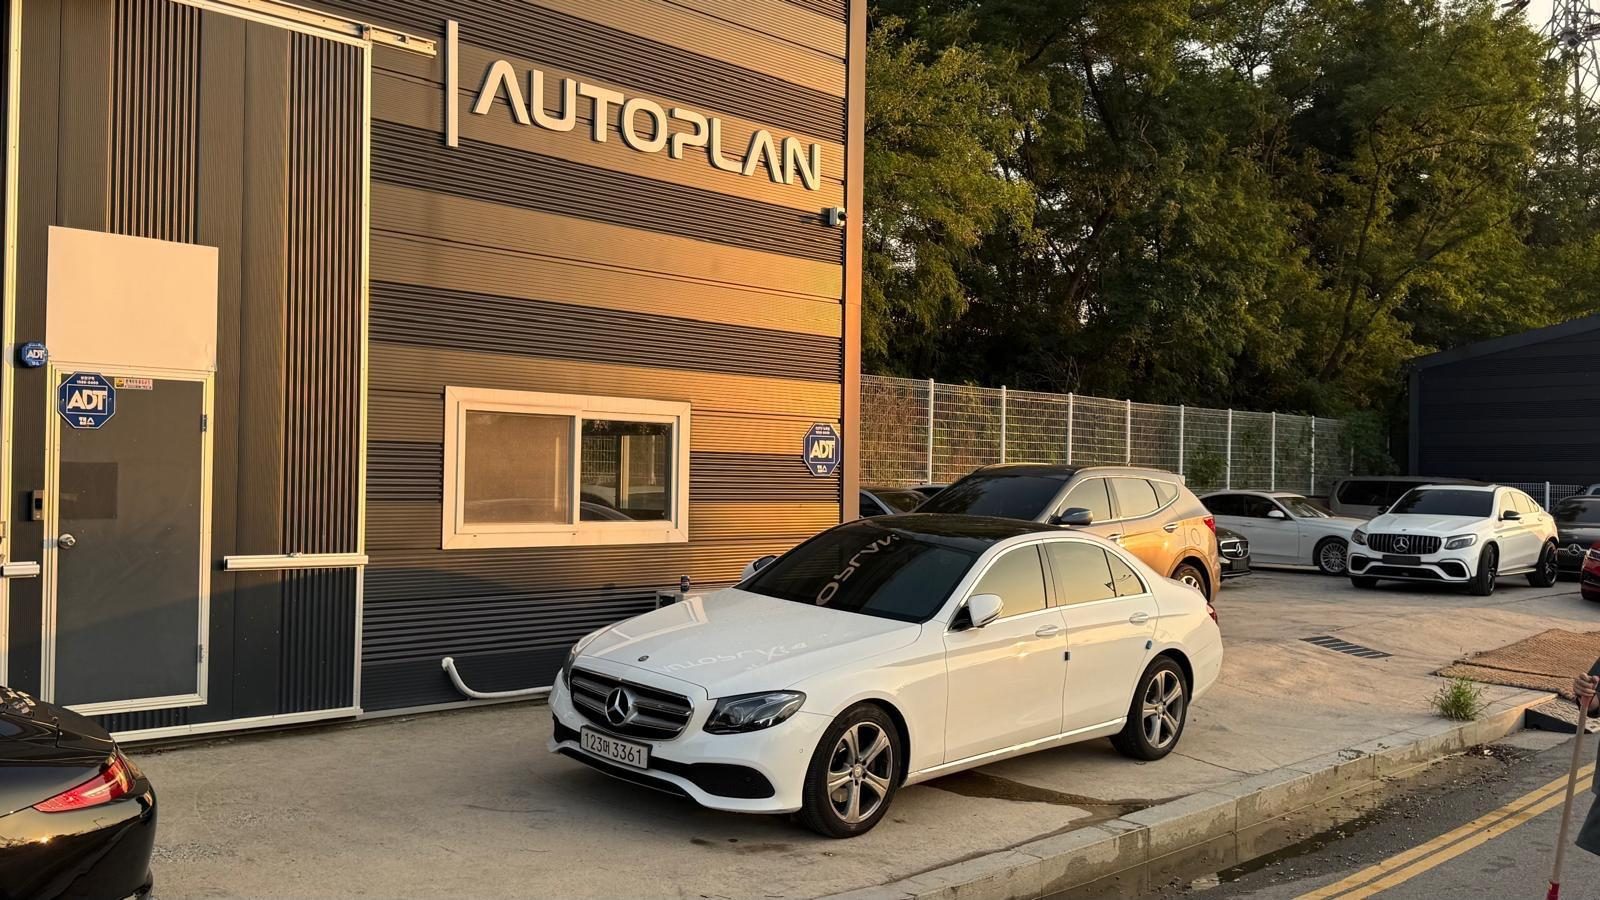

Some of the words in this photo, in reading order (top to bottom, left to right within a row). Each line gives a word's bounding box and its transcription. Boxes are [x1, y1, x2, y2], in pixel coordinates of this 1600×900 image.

[472, 59, 821, 191] AUTOPLAN
[26, 349, 45, 359] ADT
[67, 389, 107, 410] ADT
[810, 440, 835, 459] ADT
[585, 732, 610, 755] 123머
[612, 741, 641, 765] 3361
